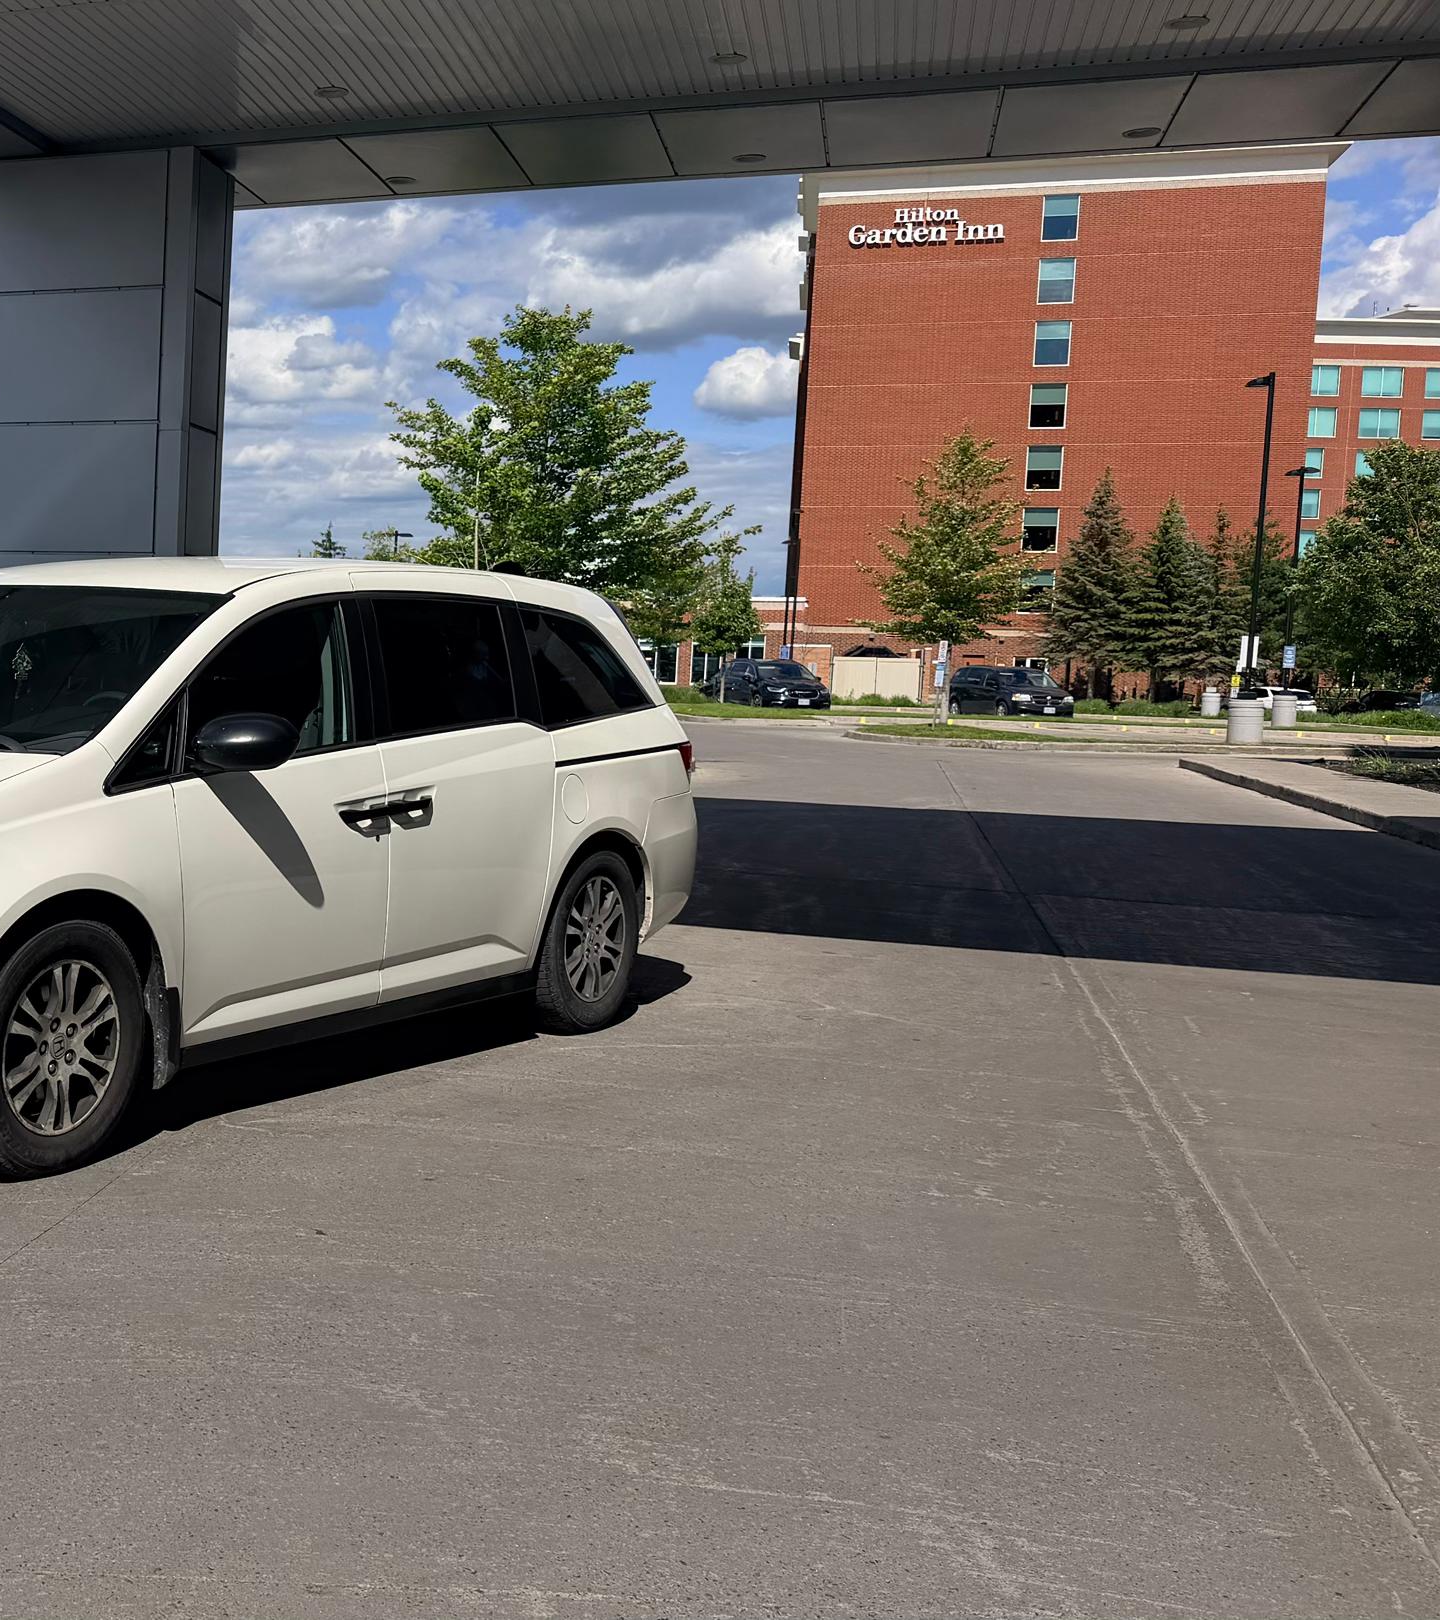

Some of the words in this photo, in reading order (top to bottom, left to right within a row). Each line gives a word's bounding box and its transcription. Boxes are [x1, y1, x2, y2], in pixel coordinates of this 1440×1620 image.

[894, 207, 960, 223] Hilton
[848, 223, 948, 245] Garden
[954, 220, 1006, 241] Inn
